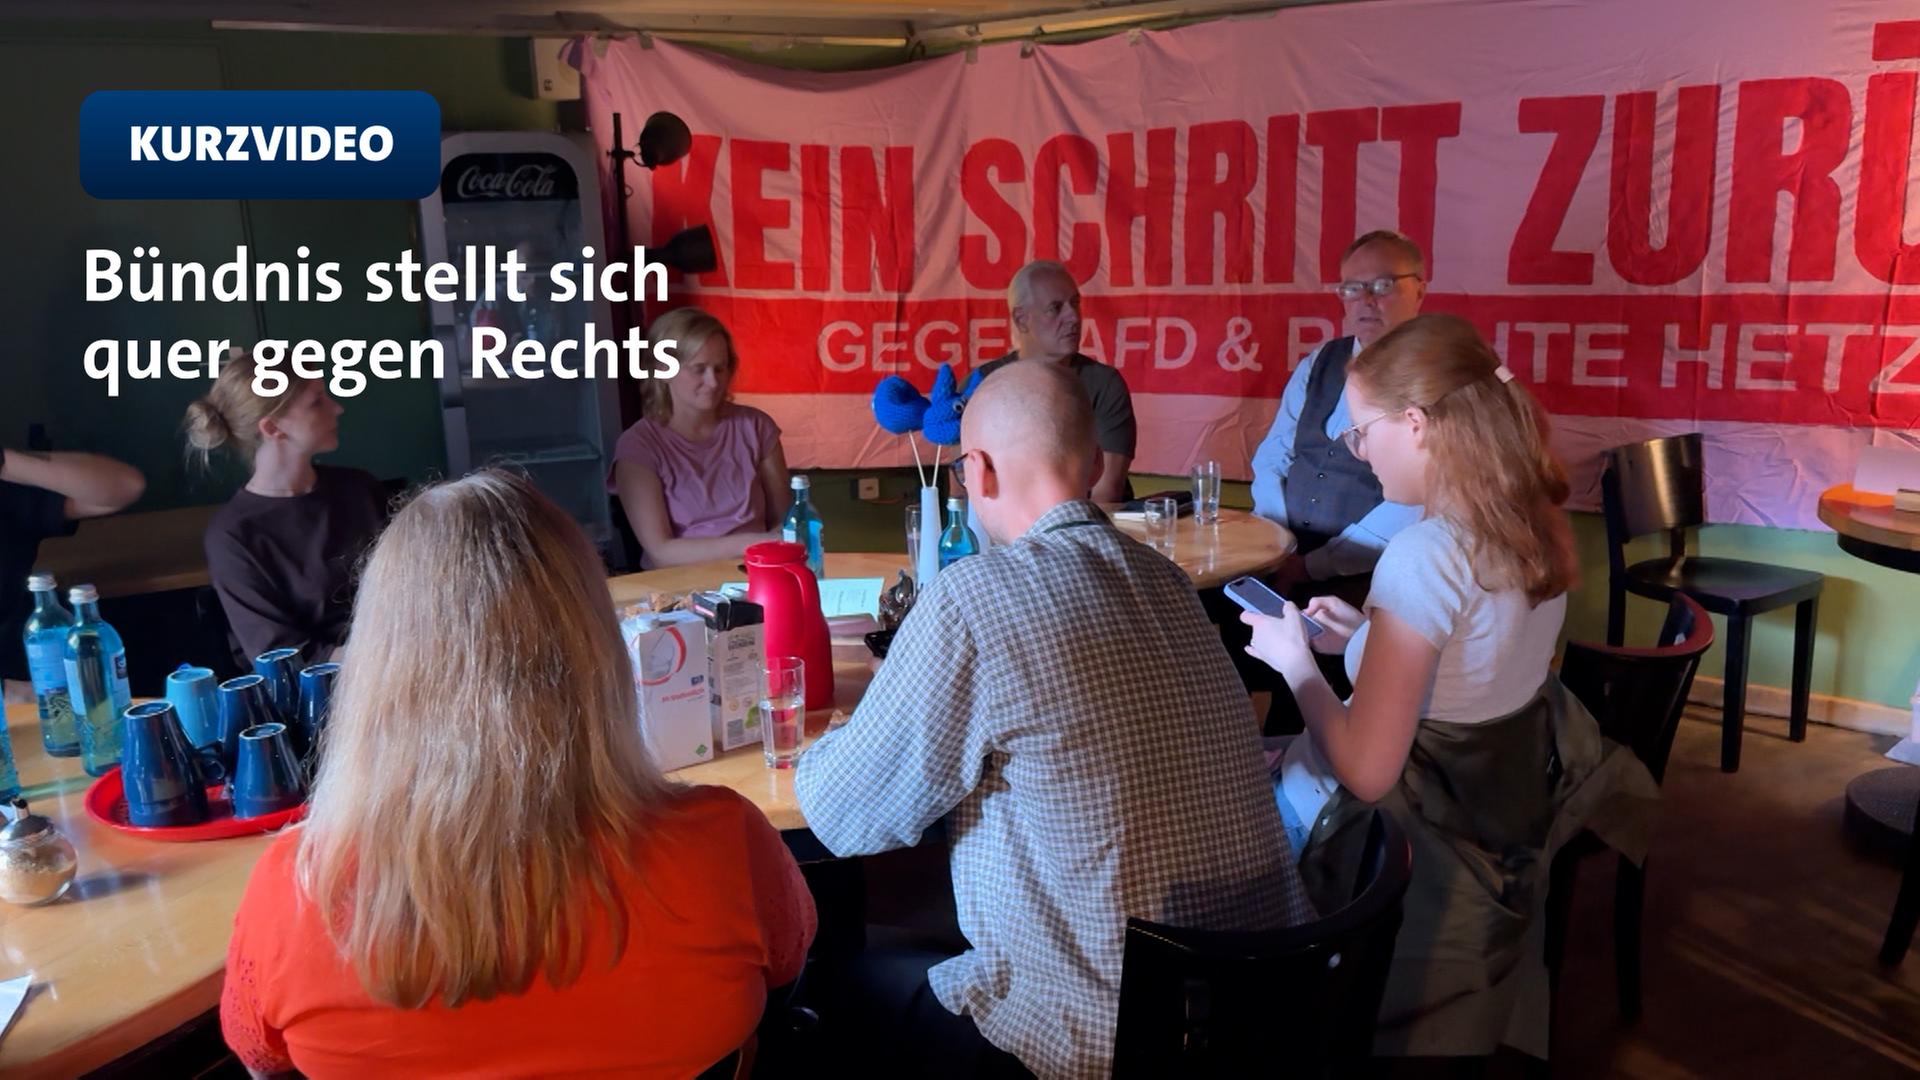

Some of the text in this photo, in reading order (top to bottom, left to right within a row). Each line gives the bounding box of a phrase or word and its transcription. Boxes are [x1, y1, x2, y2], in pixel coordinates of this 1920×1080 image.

[457, 164, 557, 198] Coca-Cola
[652, 134, 914, 294] KEIN
[959, 103, 1461, 290] SCHRITT
[817, 318, 1009, 373] GEGE
[1079, 316, 1198, 370] AFD
[1216, 316, 1263, 373] &
